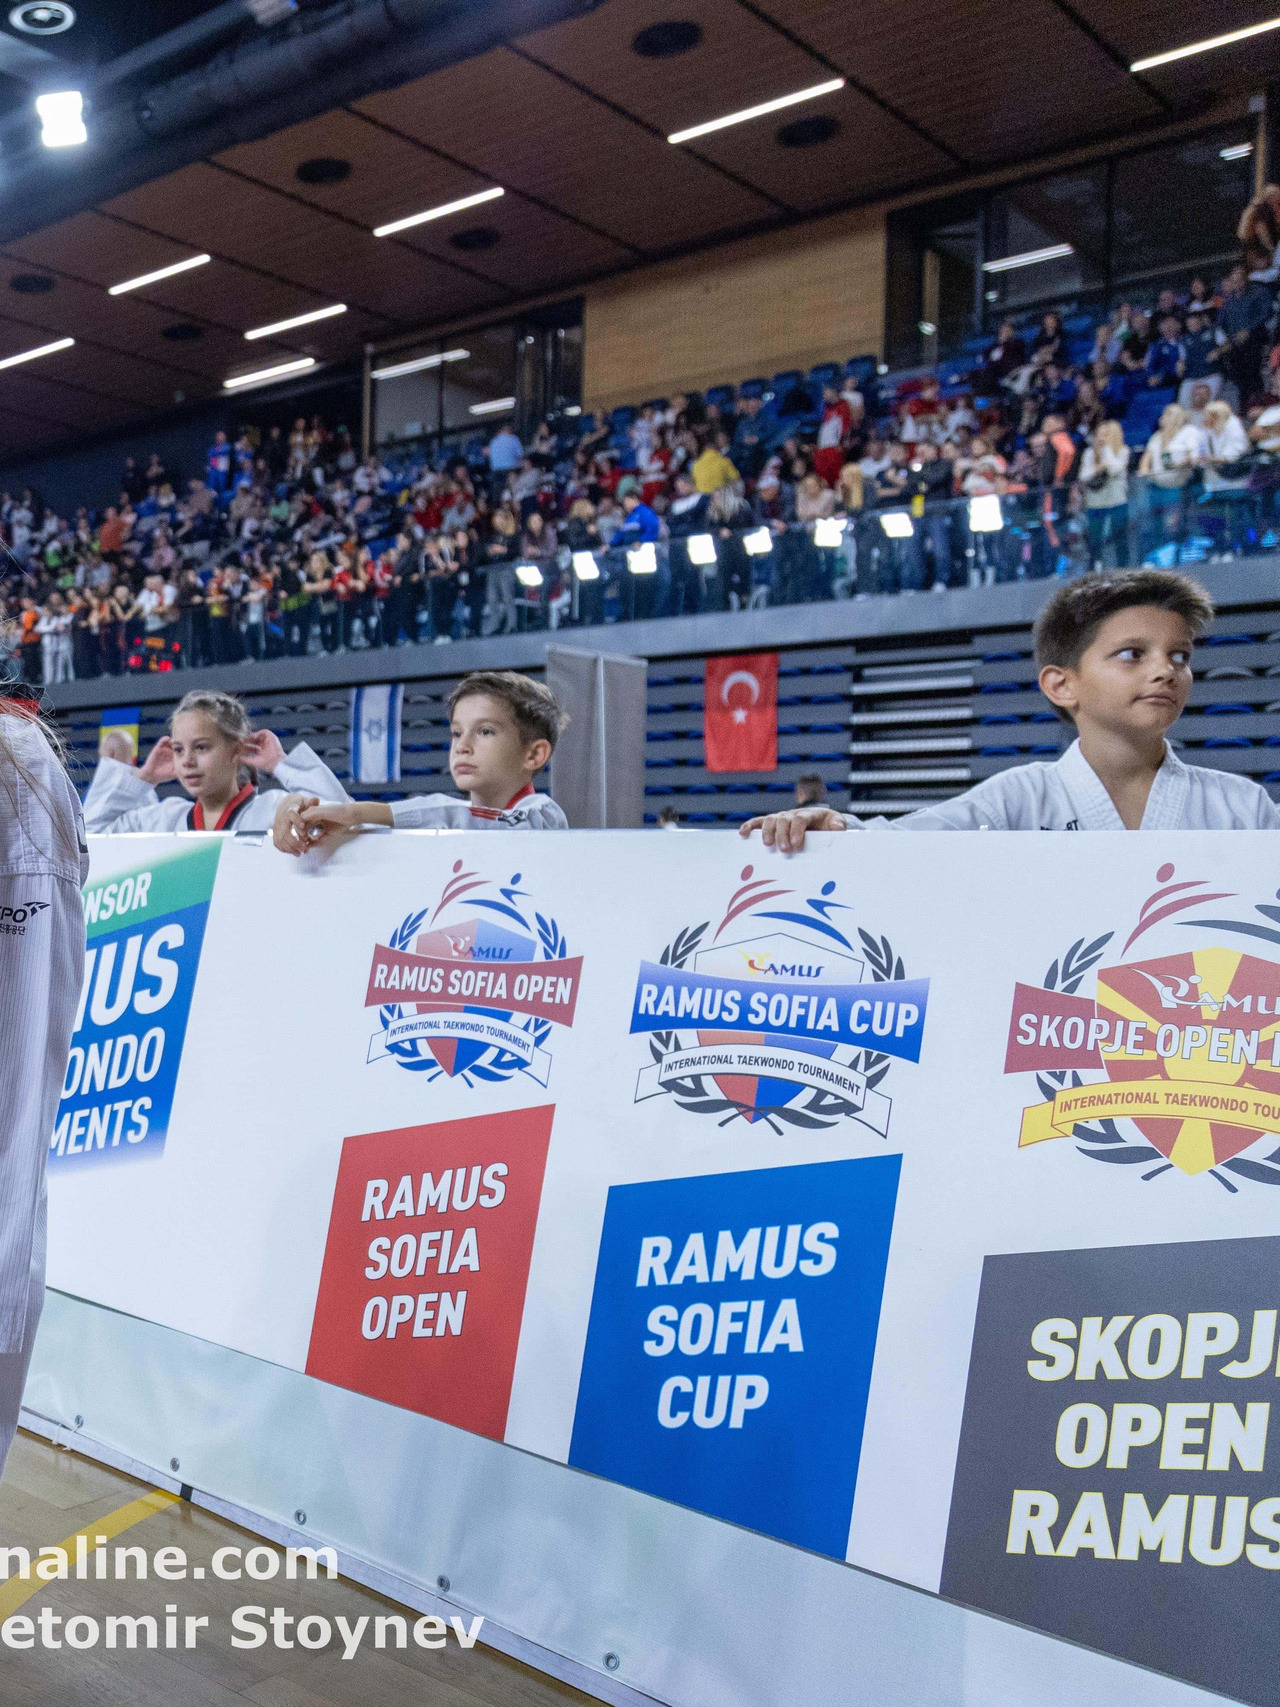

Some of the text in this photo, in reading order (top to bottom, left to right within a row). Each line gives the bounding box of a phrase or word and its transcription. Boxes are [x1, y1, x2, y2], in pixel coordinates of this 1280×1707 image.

[373, 963, 573, 1005] RAMUS SOFIA OPEN
[638, 983, 920, 1038] RAMUS SOFIA CUP
[389, 1020, 531, 1053] INTERNATIONAL TAEKWONDO TOURNAMENT
[1016, 1012, 1147, 1055] SKOPJE
[1156, 1023, 1260, 1065] OPEN
[664, 1054, 861, 1096] INTERNATIONAL TAEKWONDO TOURNAMENT
[1059, 1091, 1160, 1114] INTERNATIONAL
[1164, 1092, 1249, 1114] TAEKWONDO
[361, 1162, 509, 1222] RAMUS
[364, 1227, 480, 1280] SOFIA
[635, 1221, 840, 1288] RAMUS
[361, 1290, 467, 1341] OPEN
[643, 1297, 804, 1357] SOFIA
[1027, 1309, 1280, 1381] SKOPJ
[657, 1374, 769, 1429] CUP
[1055, 1402, 1270, 1472] OPEN
